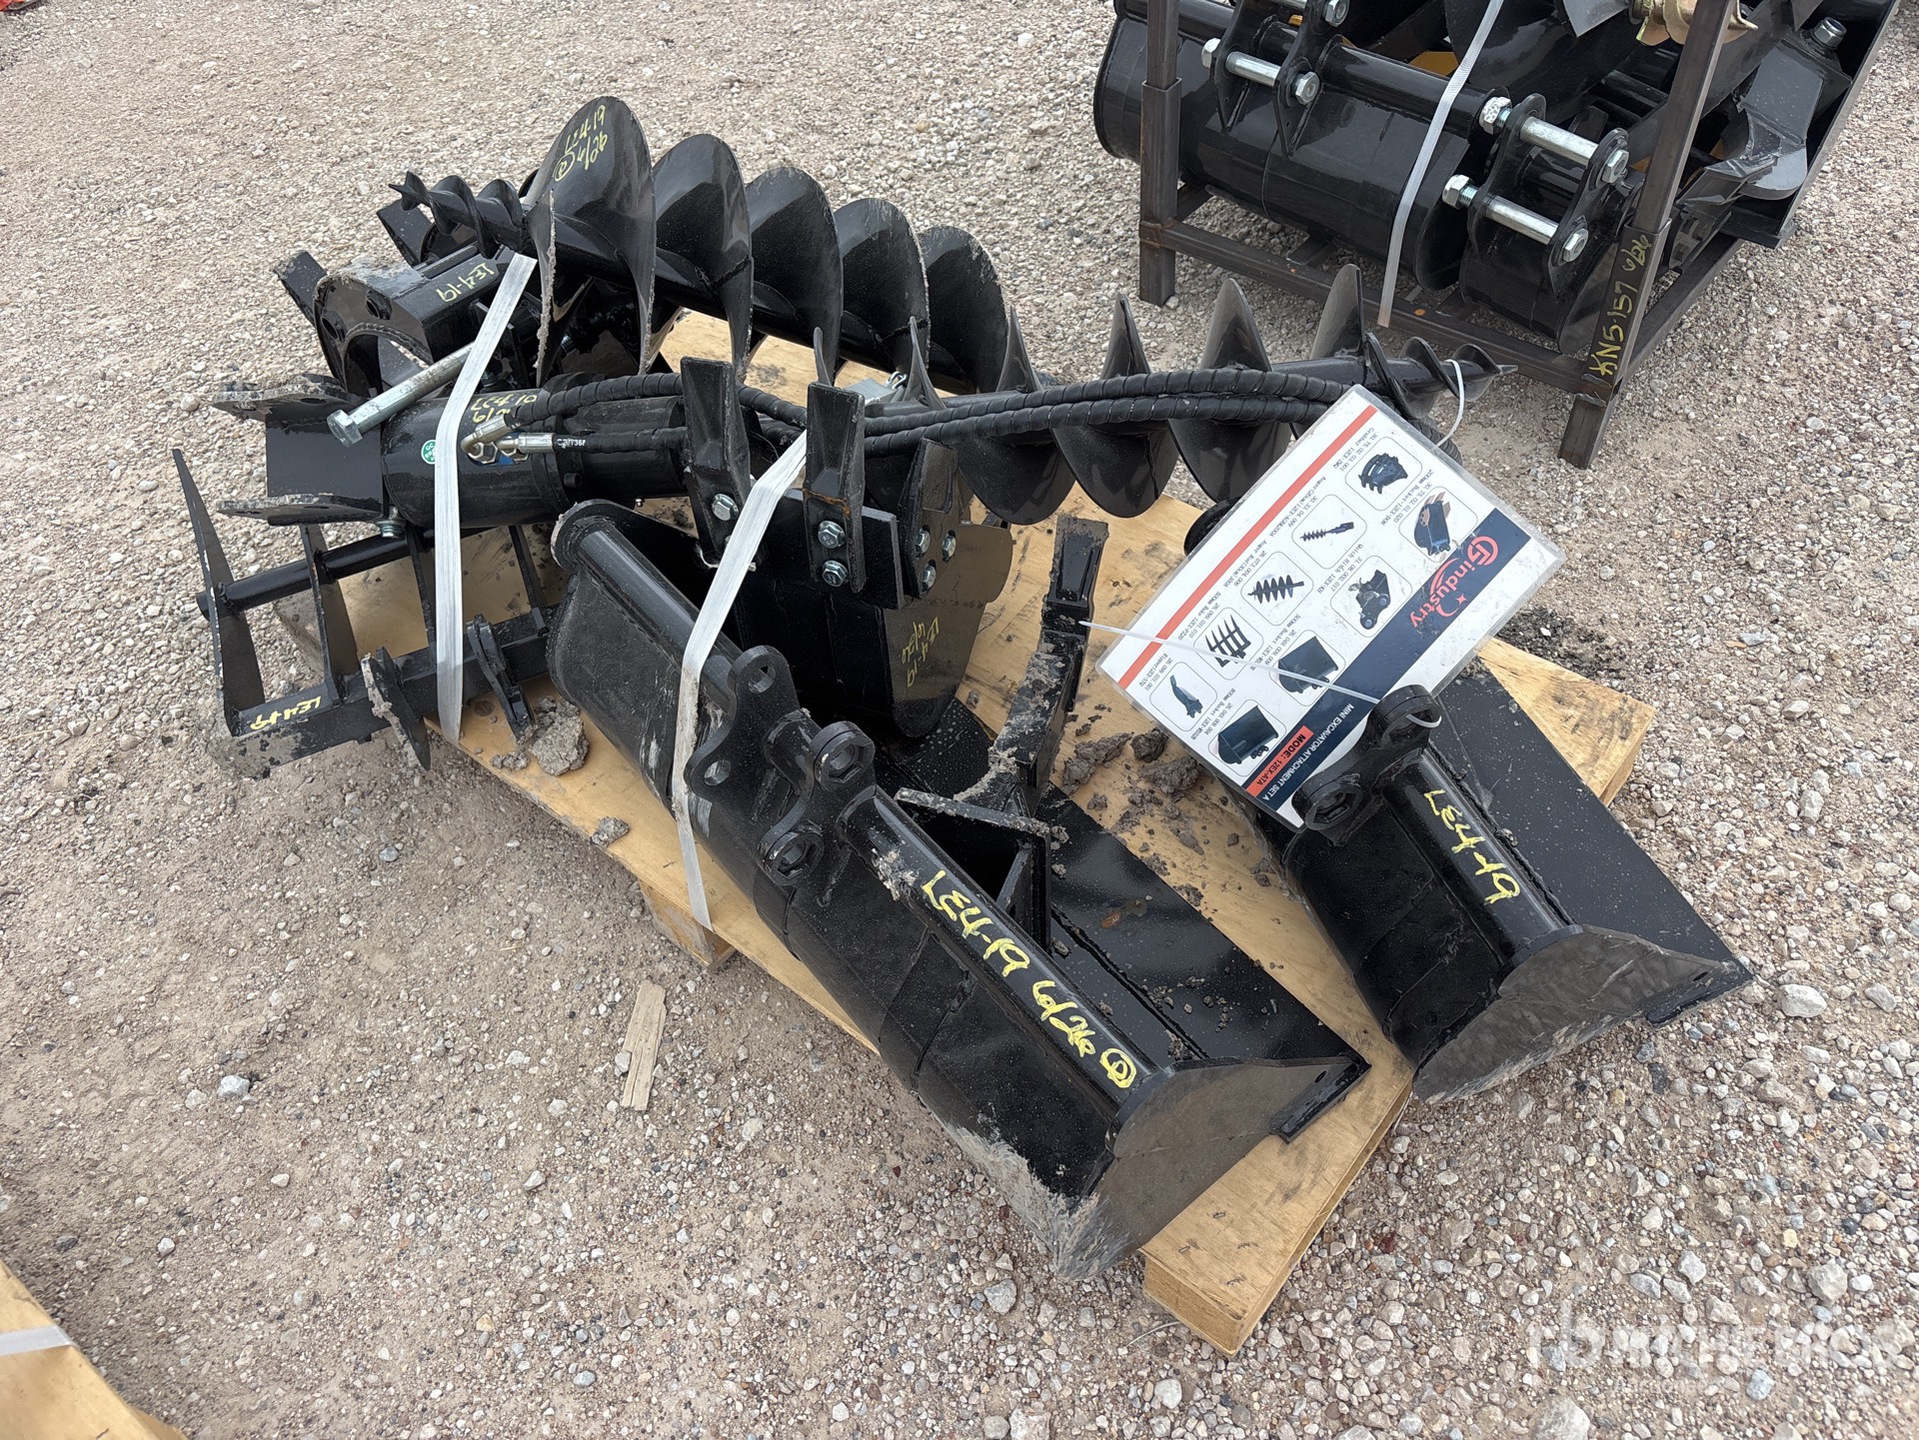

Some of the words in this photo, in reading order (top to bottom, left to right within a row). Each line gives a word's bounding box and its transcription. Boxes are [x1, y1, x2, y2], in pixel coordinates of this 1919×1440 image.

[1337, 702, 1354, 719] MINI
[1279, 732, 1306, 761] MODE:
[1306, 715, 1343, 753] EXCAVATOR
[1255, 757, 1283, 787] 12EX-ATA
[1275, 748, 1312, 787] ATTACHMENT
[1261, 792, 1271, 802] A
[1266, 782, 1280, 797] SET
[921, 869, 1030, 978] LE4-19
